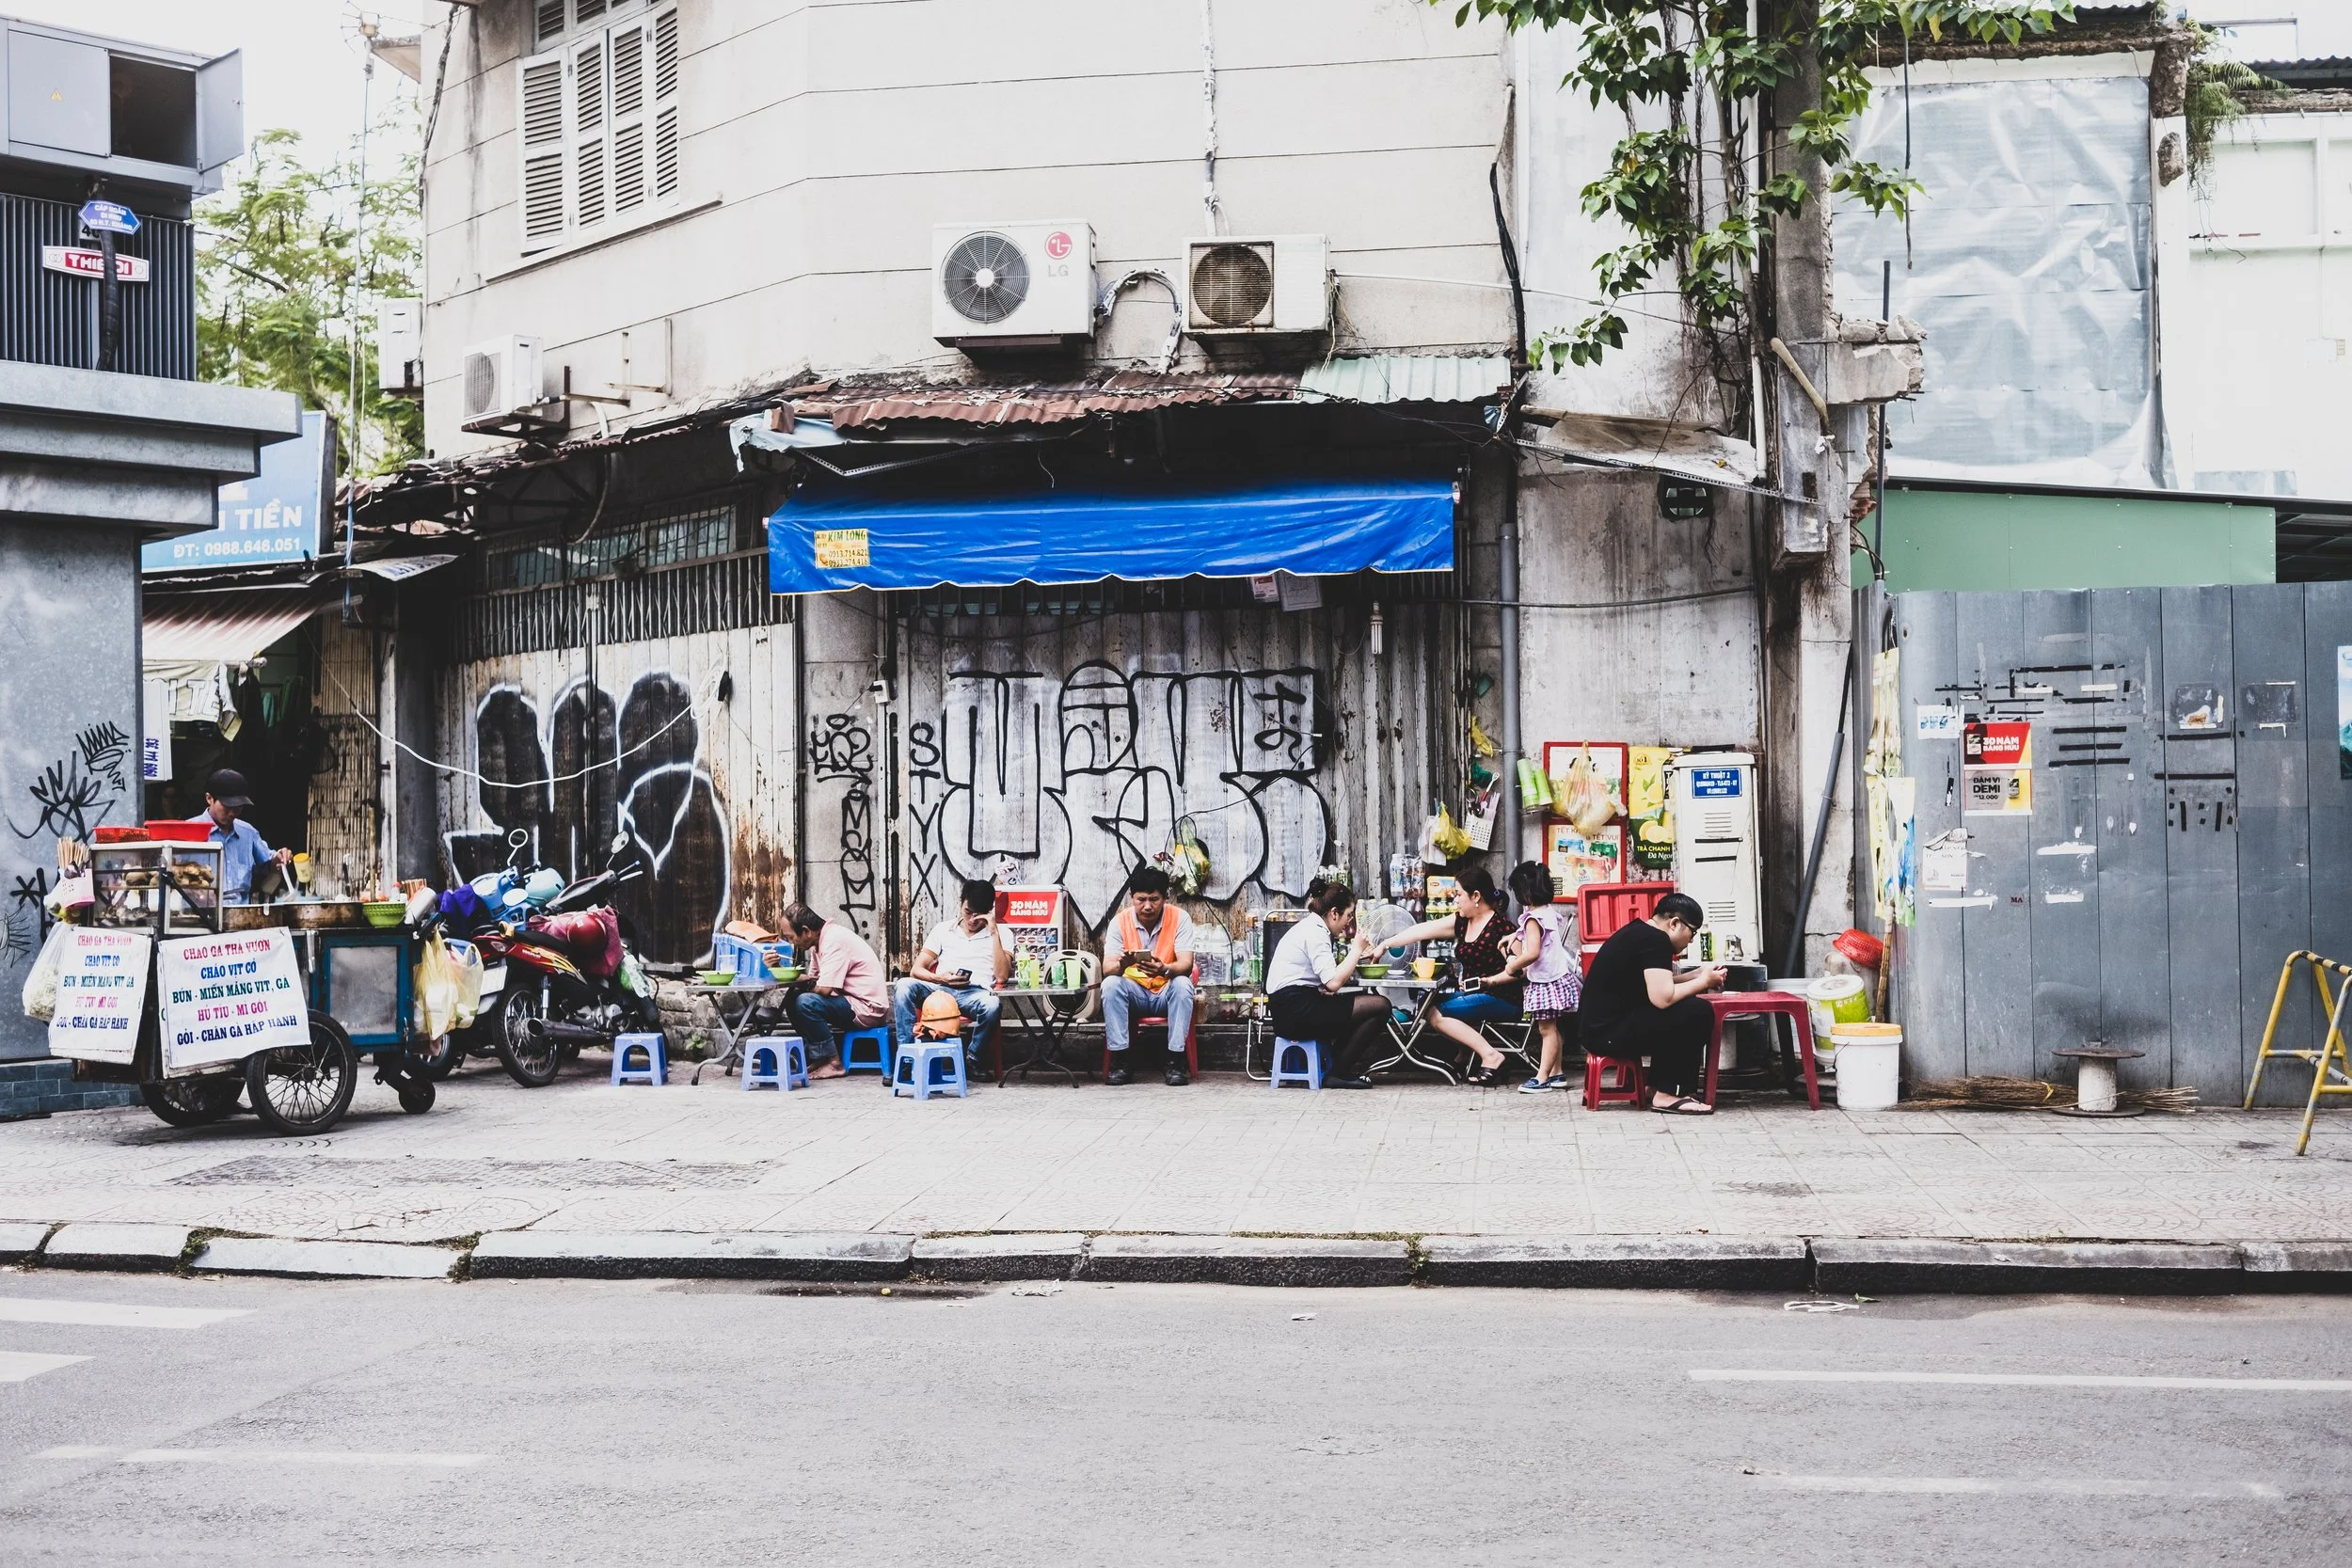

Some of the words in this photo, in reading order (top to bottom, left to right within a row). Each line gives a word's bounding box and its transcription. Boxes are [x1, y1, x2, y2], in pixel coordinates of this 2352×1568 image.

[1047, 264, 1069, 277] LG
[828, 531, 844, 543] KIM
[846, 530, 866, 541] LONG
[1010, 900, 1024, 910] 30
[200, 963, 226, 979] CHÁO
[172, 988, 192, 1004] BÚN
